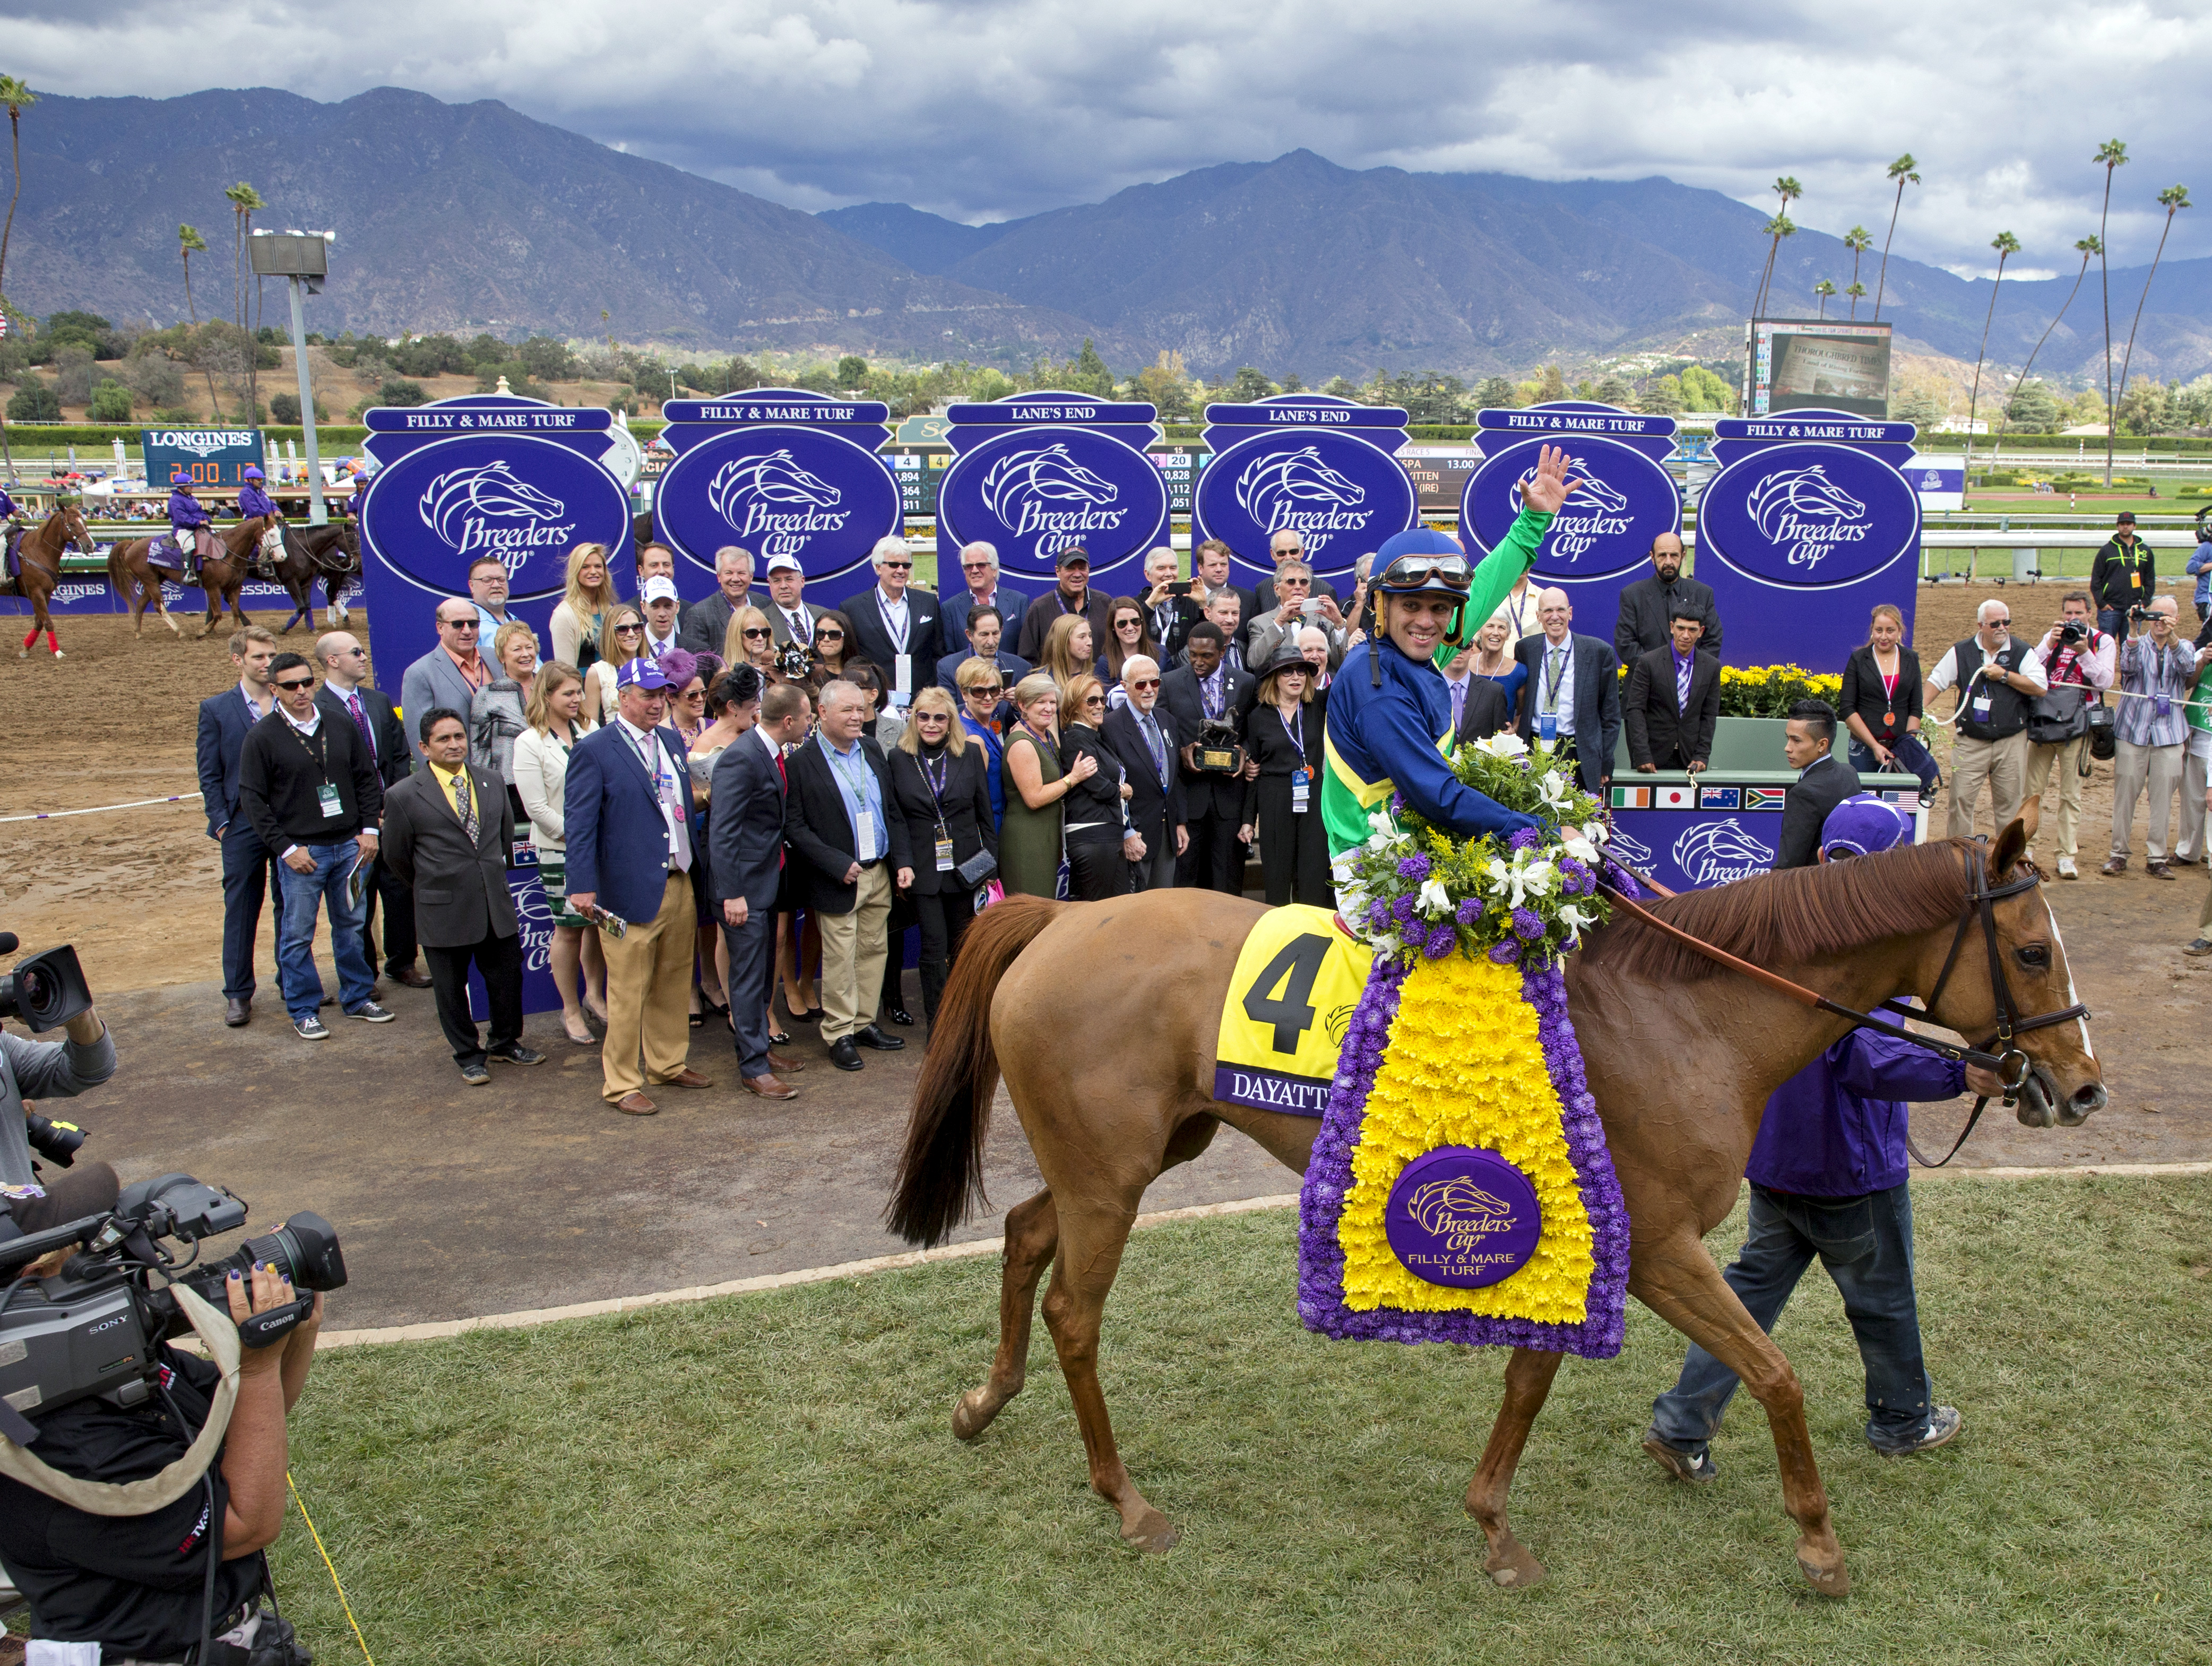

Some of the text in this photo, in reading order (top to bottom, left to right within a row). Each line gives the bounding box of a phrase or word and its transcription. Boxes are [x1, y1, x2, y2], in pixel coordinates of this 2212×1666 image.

[407, 414, 575, 427] FILLY & MARE TURF
[701, 407, 854, 420] FILLY & MARE TURF
[1012, 408, 1096, 419] LANE'S END
[1269, 410, 1350, 422] LANE'S END
[1508, 415, 1645, 432] FILLY & MARE TURF
[1747, 425, 1885, 439] FILLY & MARE TURF
[149, 431, 253, 447] LONGINES
[903, 456, 943, 467] 4 4
[1171, 456, 1186, 465] 20
[1399, 459, 1474, 469] SPA 13.00
[1161, 470, 1190, 481] 0,828
[1419, 484, 1439, 494] (IRE)
[741, 502, 851, 538] Breeders'
[1014, 500, 1128, 538] Breeders'
[1265, 500, 1373, 535] Breeders'
[457, 516, 576, 555] Breeders'
[1771, 513, 1872, 545] Breeders'
[761, 531, 806, 558] Cup
[1550, 532, 1592, 563] Cup
[1787, 540, 1830, 569] Cup
[527, 945, 553, 973] Cu
[1242, 933, 1333, 1056] 4
[1232, 1073, 1333, 1110] DAYATT
[1431, 1212, 1517, 1237] Breeders'
[1446, 1231, 1481, 1255] Cup
[1408, 1253, 1515, 1264] FILLY & MARE
[1439, 1265, 1486, 1276] TURF
[89, 1315, 128, 1335] SONY
[260, 1313, 295, 1331] Canon
